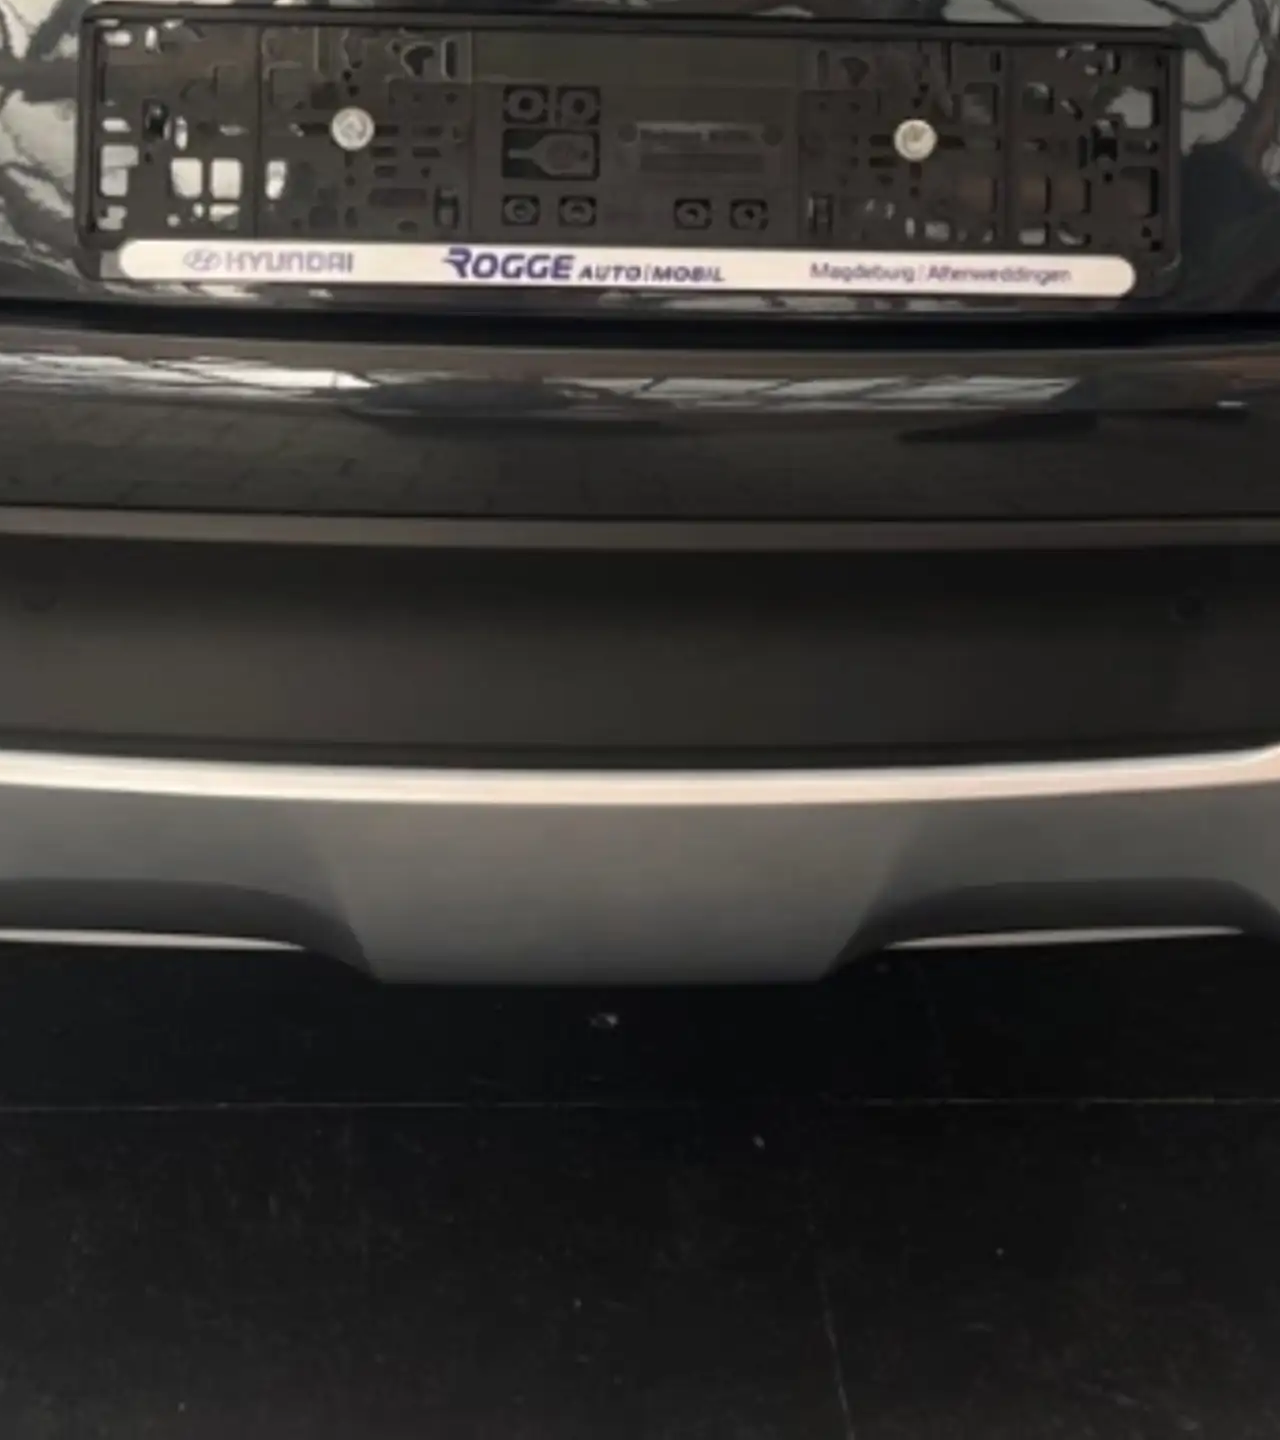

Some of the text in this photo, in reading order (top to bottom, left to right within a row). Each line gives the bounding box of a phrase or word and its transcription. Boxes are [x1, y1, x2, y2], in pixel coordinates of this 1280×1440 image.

[225, 250, 355, 274] HYUNDAI
[444, 246, 577, 280] ROGGE
[809, 262, 916, 283] Magdeburg
